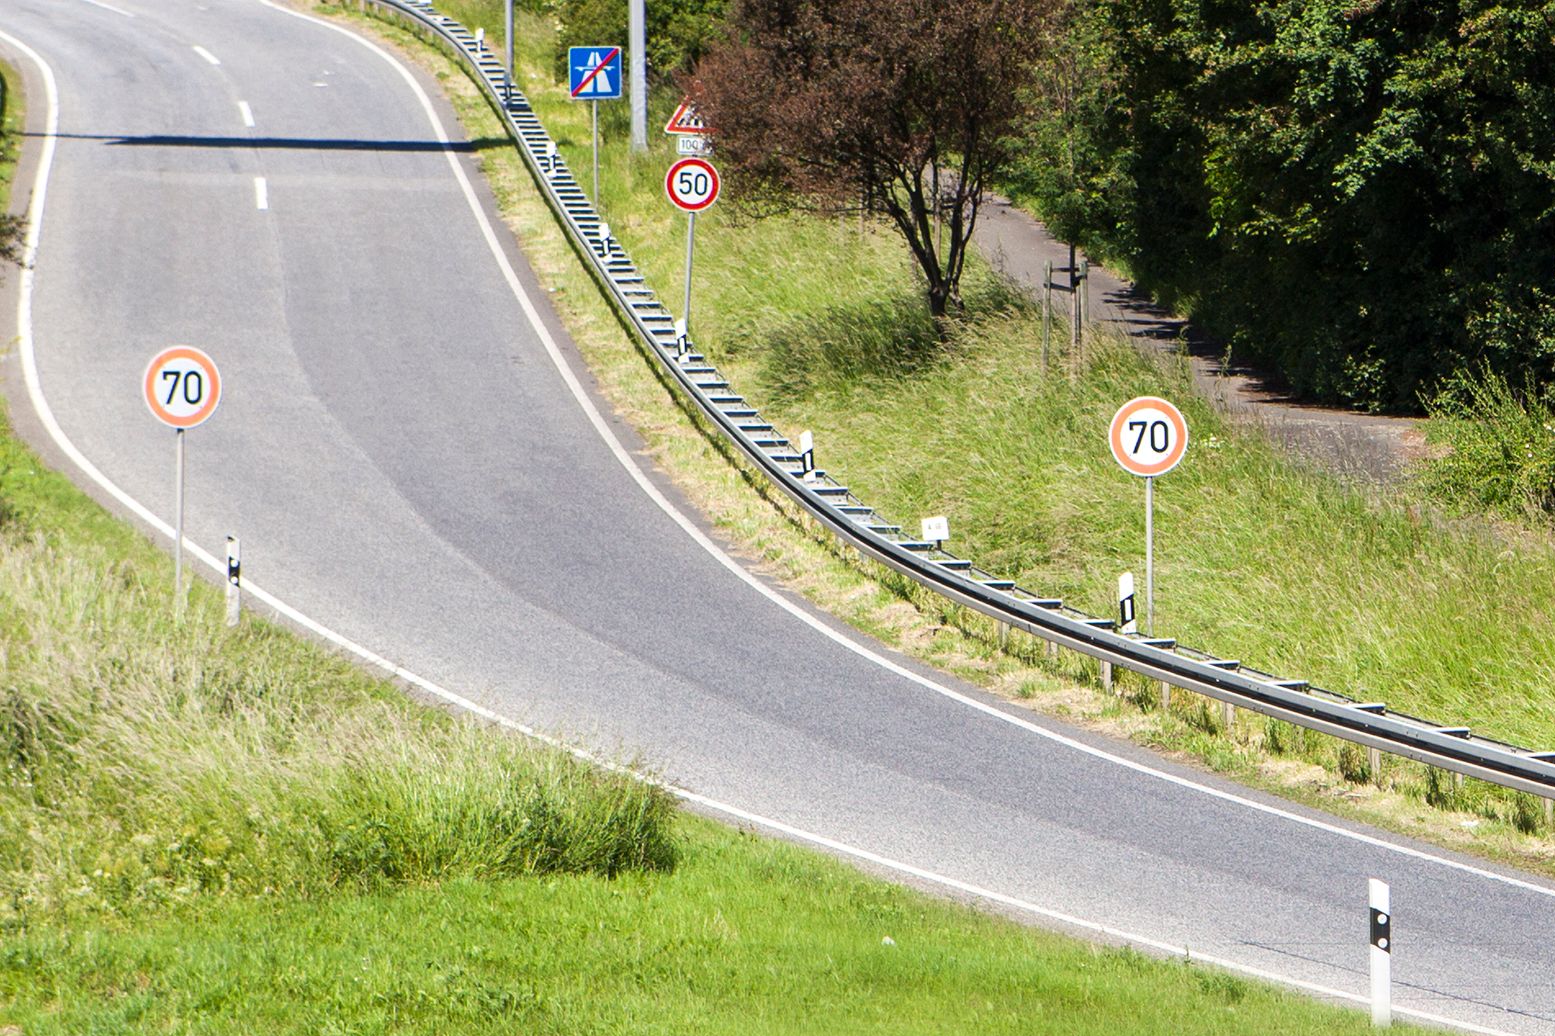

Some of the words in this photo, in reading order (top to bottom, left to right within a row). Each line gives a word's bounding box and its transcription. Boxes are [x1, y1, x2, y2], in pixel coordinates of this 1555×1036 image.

[679, 172, 708, 196] 50
[162, 371, 203, 405] 70
[1129, 420, 1169, 454] 70
